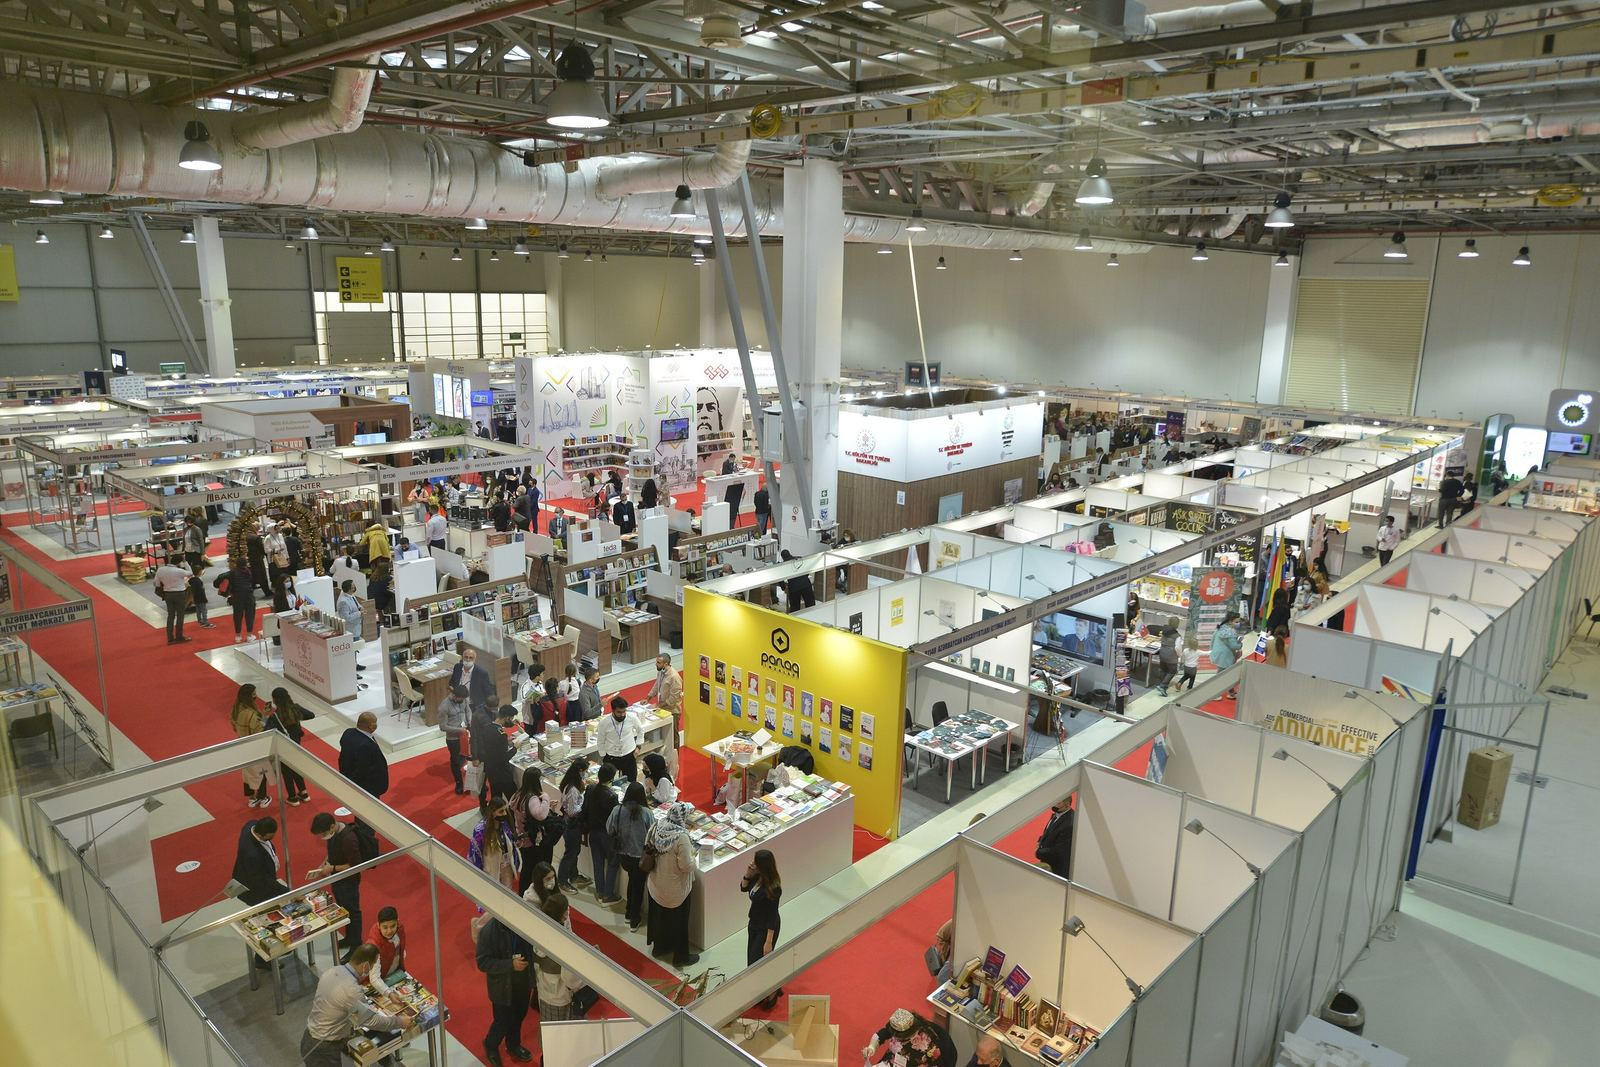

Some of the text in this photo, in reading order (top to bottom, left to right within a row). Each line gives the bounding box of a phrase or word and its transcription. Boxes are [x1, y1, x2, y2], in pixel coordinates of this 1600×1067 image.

[214, 482, 321, 501] BAKU BOOK CENTER
[603, 544, 617, 552] teda
[331, 642, 351, 652] teda
[1279, 709, 1315, 725] COMMERCIAL
[1272, 715, 1370, 754] ADVANCE
[1340, 724, 1379, 742] EFFECTIVE
